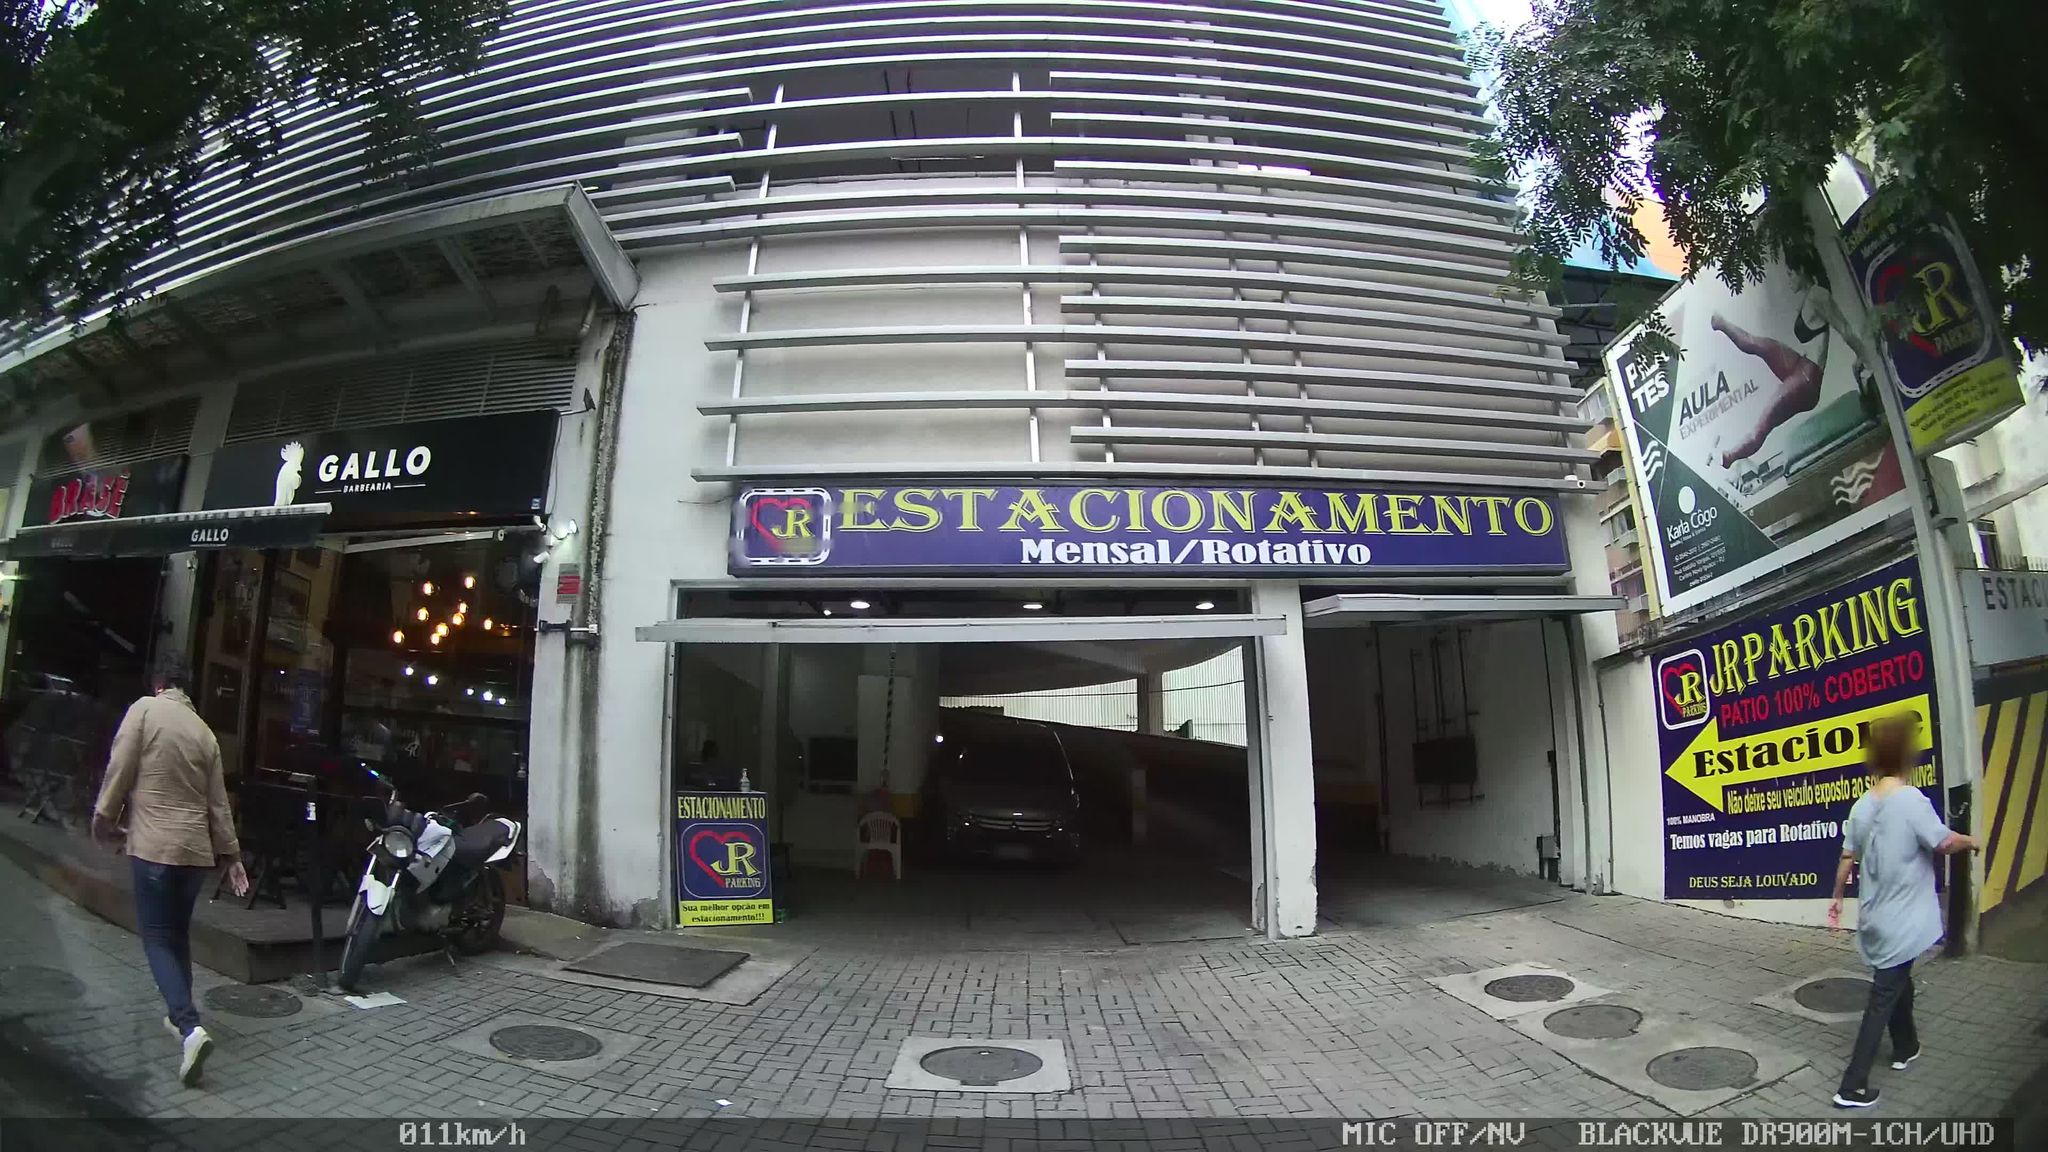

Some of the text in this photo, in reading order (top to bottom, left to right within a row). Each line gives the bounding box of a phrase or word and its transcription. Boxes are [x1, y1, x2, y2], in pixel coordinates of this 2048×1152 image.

[1631, 370, 1670, 414] TES
[1680, 370, 1730, 426] AULA
[318, 445, 431, 482] GALLO
[343, 482, 392, 493] BARBEARIA
[771, 509, 815, 539] JR
[837, 487, 1554, 537] ESTACIONAMENTO
[1666, 519, 1690, 541] Karla
[1690, 506, 1718, 528] Côgo
[191, 528, 229, 542] GALLO
[1020, 538, 1371, 565] Mensal/Rotativo
[1674, 672, 1706, 706] JR
[1721, 650, 1925, 729] PATIO 100% COBERTO
[677, 796, 766, 819] ESTACIONAMENTO
[1727, 789, 1744, 815] Não
[1744, 786, 1766, 813] deixe
[1766, 790, 1782, 811] seu
[1815, 774, 1849, 810] exposto
[1851, 777, 1864, 798] ao
[1682, 813, 1716, 824] MANOBRA
[1670, 833, 1706, 850] Temos
[1707, 830, 1744, 849] vagas
[1746, 827, 1777, 847] para
[1779, 820, 1838, 844] Rotativo
[710, 842, 762, 876] JR
[725, 878, 761, 888] PARKING
[1689, 871, 1818, 888] DEUS SEJA LOUVADO
[682, 904, 698, 912] Sua
[700, 903, 729, 911] melhor
